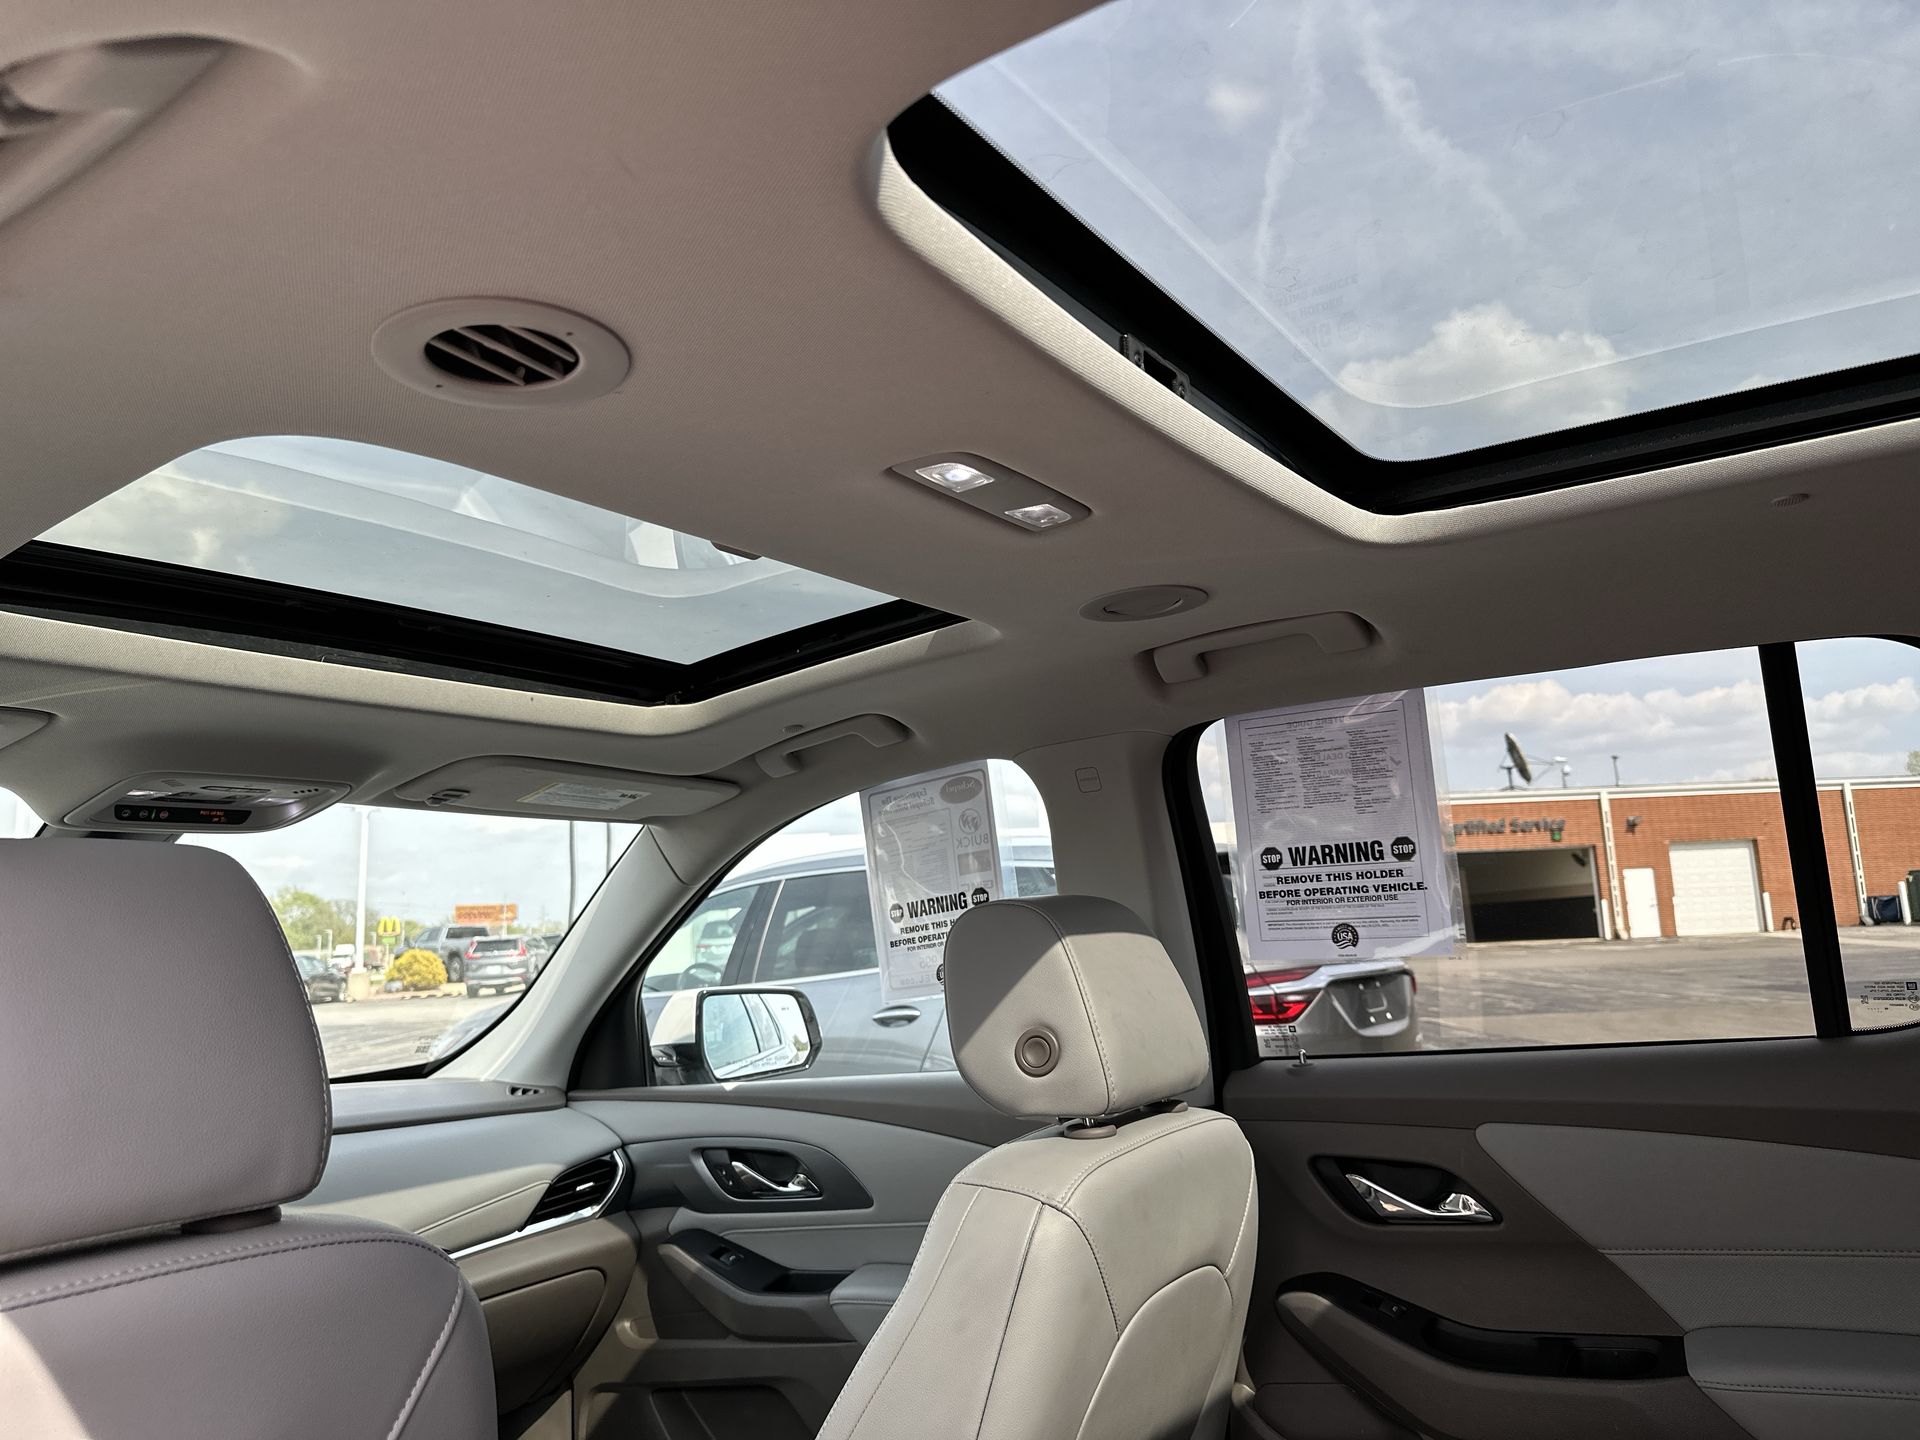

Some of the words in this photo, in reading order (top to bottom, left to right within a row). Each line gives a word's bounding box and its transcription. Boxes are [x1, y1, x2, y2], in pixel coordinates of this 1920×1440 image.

[1262, 853, 1281, 864] STOP
[1287, 840, 1385, 867] WARNING
[1392, 843, 1414, 855] STOP
[1276, 872, 1323, 885] REMOVE
[1325, 871, 1352, 882] THIS
[1356, 869, 1404, 880] HOLDER
[1258, 888, 1301, 900] BEFORE
[1303, 884, 1370, 897] OPERATING
[1372, 882, 1428, 894] VEHICLE.
[907, 891, 968, 919] WARNING
[972, 893, 988, 903] STOP
[1286, 898, 1301, 906] FOR
[1302, 896, 1332, 905] INTERIOR
[1334, 896, 1346, 904] OR
[1346, 895, 1382, 903] EXTERIOR
[1383, 894, 1399, 902] USE
[900, 923, 930, 935] REMOVE
[931, 919, 948, 930] THIS
[890, 937, 917, 948] BEFORE
[1337, 931, 1352, 942] USA
[916, 942, 937, 950] INTERIOR
